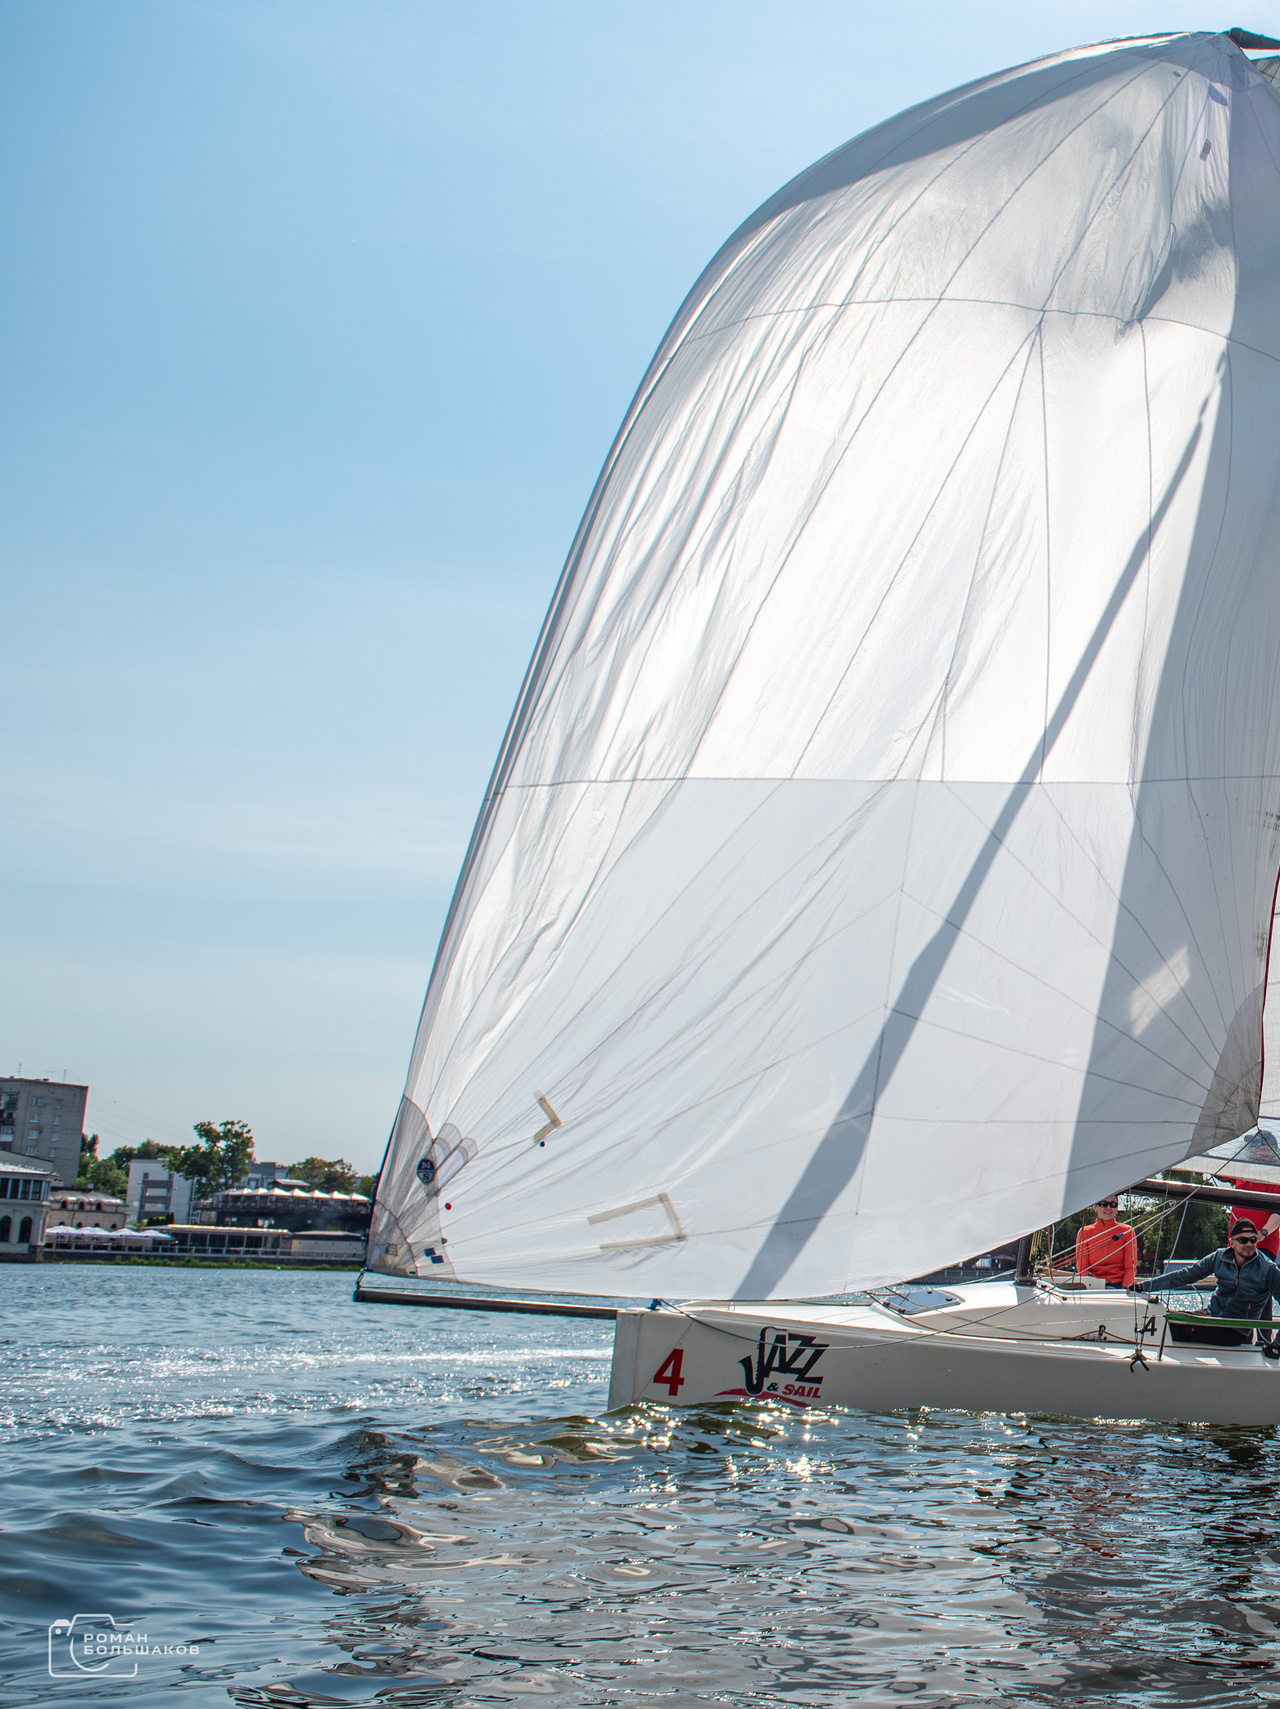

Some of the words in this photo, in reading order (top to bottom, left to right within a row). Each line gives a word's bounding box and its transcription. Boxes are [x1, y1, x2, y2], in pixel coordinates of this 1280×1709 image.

[1142, 1315, 1157, 1336] 4
[653, 1348, 685, 1396] 4
[738, 1326, 830, 1395] JAZZ
[766, 1382, 779, 1392] &
[782, 1383, 822, 1399] SAIL
